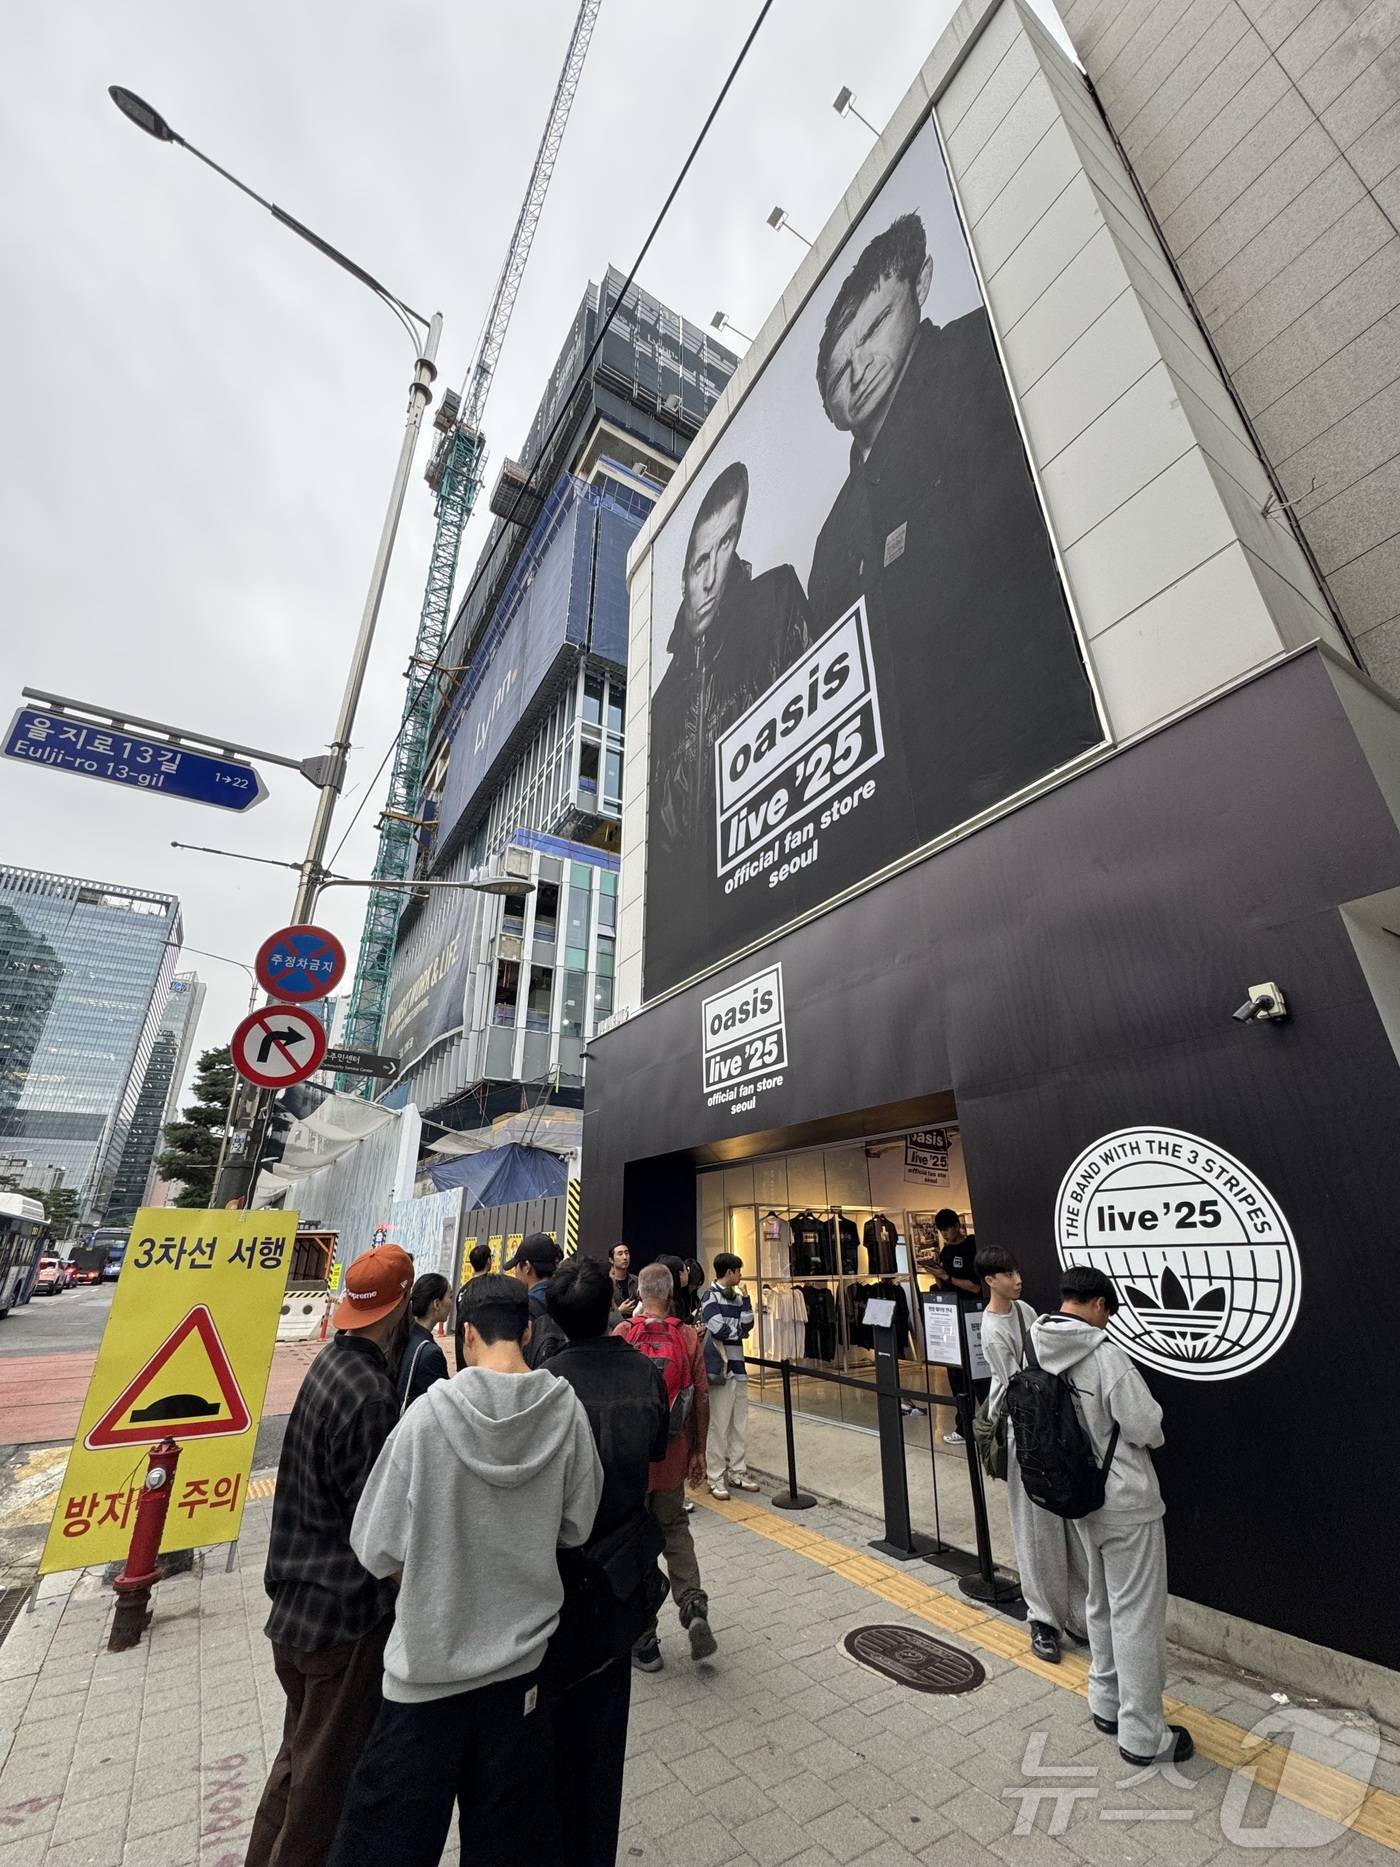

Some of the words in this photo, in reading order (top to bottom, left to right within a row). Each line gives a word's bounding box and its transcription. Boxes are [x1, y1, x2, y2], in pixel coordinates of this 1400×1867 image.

[729, 651, 850, 784] oasis
[25, 717, 183, 775] 을지로13길
[14, 739, 98, 772] Eulji-ro
[106, 760, 165, 789] 13-gil
[724, 841, 779, 895] official
[783, 821, 814, 855] fan
[820, 779, 877, 830] store
[727, 788, 790, 858] live
[768, 839, 820, 889] seoul
[271, 953, 334, 973] 주정차금지
[710, 987, 774, 1036] oasis
[709, 1055, 742, 1084] live
[707, 1086, 738, 1107] official
[739, 1083, 754, 1098] fan
[756, 1075, 784, 1091] store
[731, 1095, 756, 1115] seoul
[911, 1151, 929, 1165] live
[1098, 1140, 1142, 1166] WITH
[1145, 1139, 1183, 1160] THE
[1187, 1150, 1199, 1165] 3
[1070, 1161, 1102, 1204] BAND
[1202, 1158, 1272, 1234] STRIPES
[1066, 1205, 1081, 1239] THE
[1097, 1205, 1159, 1232] live
[133, 1236, 218, 1271] 3차선
[228, 1236, 287, 1269] 서행
[62, 1490, 140, 1538] 방지
[177, 1473, 242, 1519] 주의
